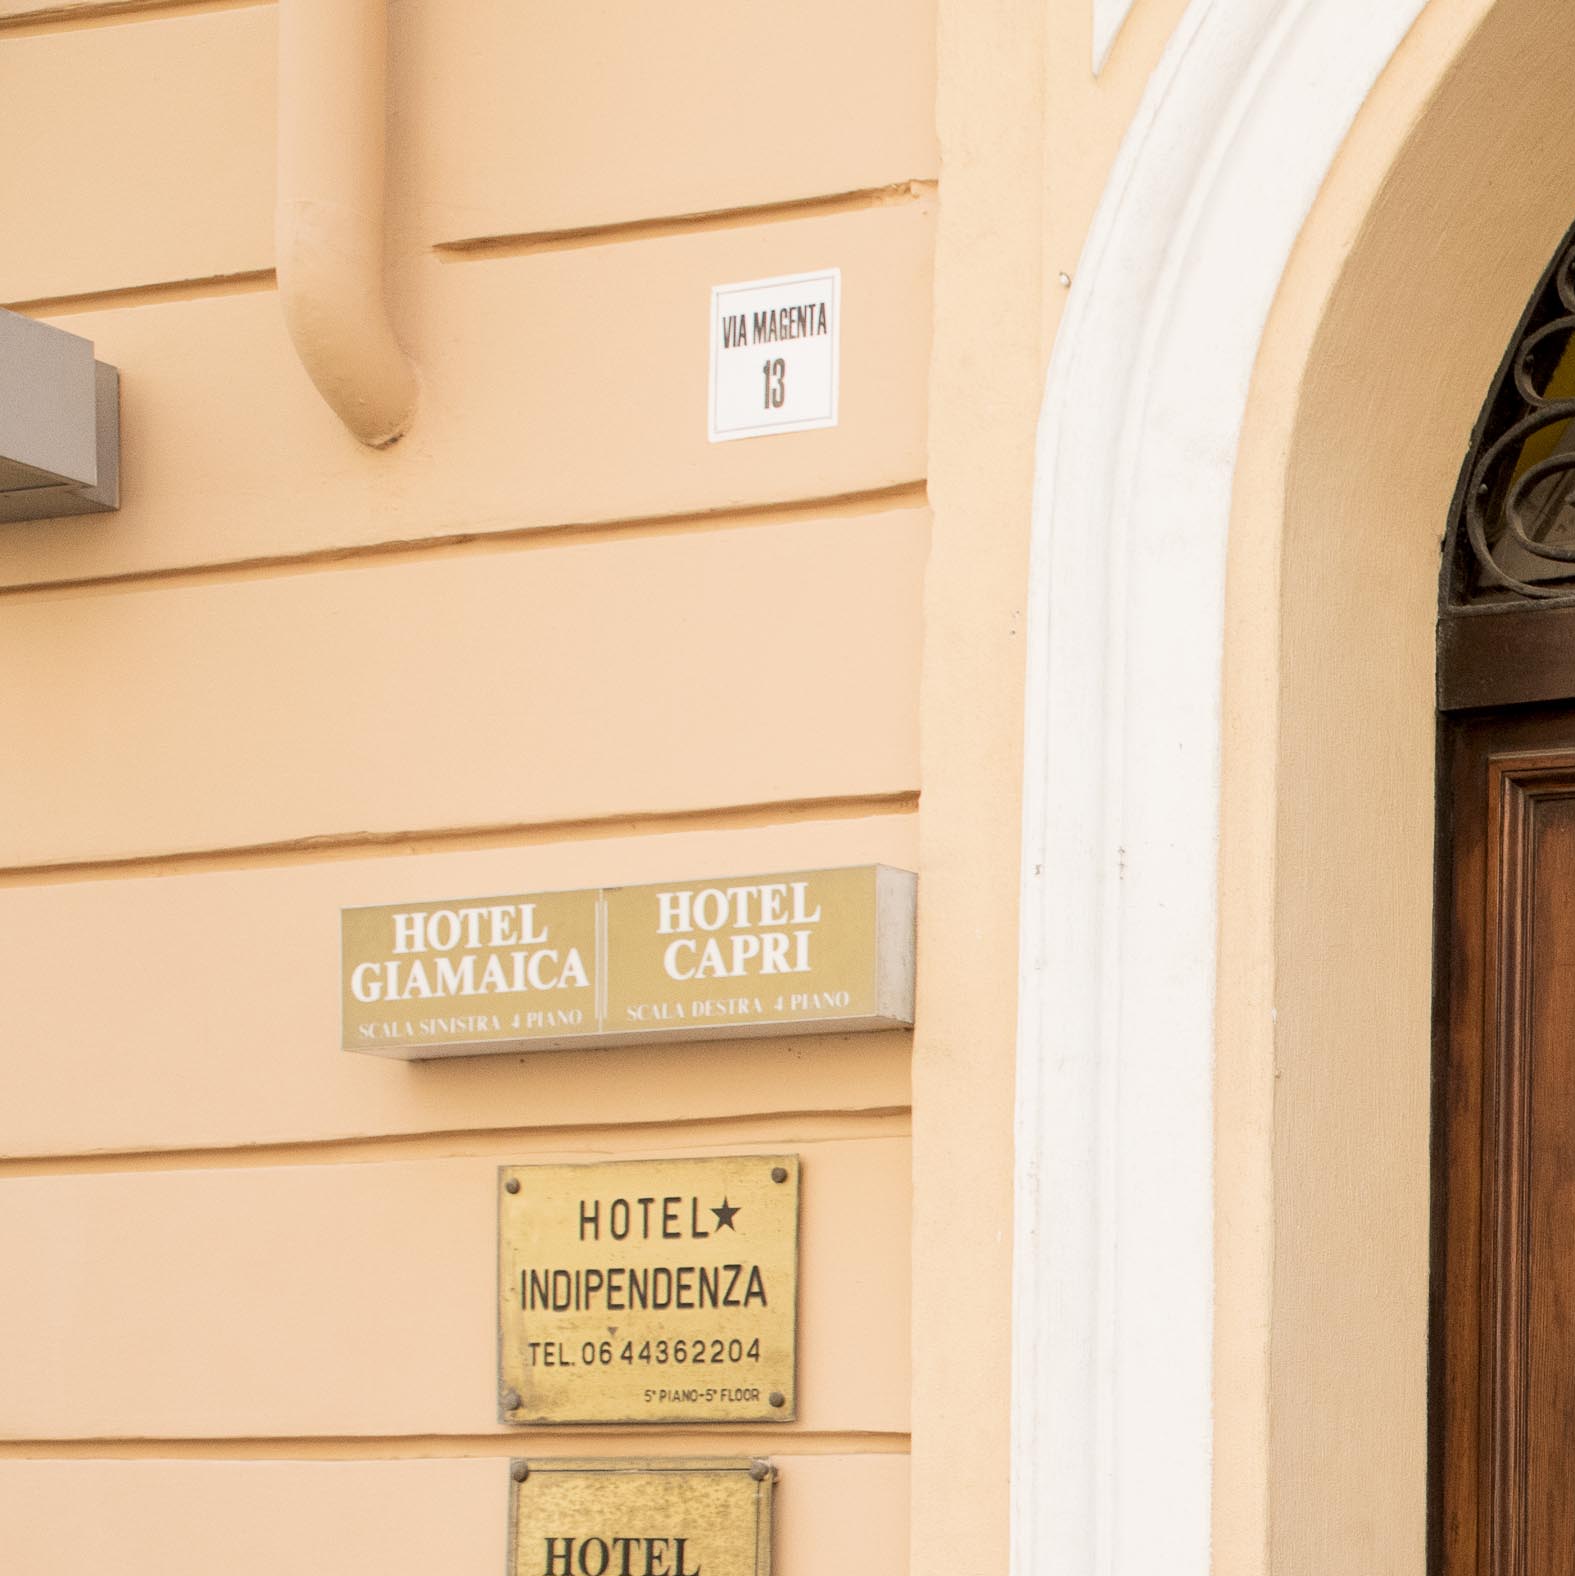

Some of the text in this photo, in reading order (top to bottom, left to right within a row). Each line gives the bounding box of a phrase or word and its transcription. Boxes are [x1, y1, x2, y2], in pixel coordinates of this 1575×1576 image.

[722, 302, 827, 349] VIA MAGENTA
[762, 357, 786, 409] 13
[392, 904, 549, 954] HOTEL
[655, 881, 821, 934] HOTEL
[350, 947, 591, 1003] GIAMAICA
[662, 930, 813, 981] CAPRI
[358, 1008, 583, 1039] SCALA SINISTRA 4 PIANO
[626, 991, 850, 1021] SCALA DESTRA 4 PIANO
[579, 1196, 709, 1241] HOTEL
[520, 1264, 767, 1312] INDIPENDENZA
[528, 1342, 576, 1367] TEL.
[720, 1387, 760, 1402] FLOOR
